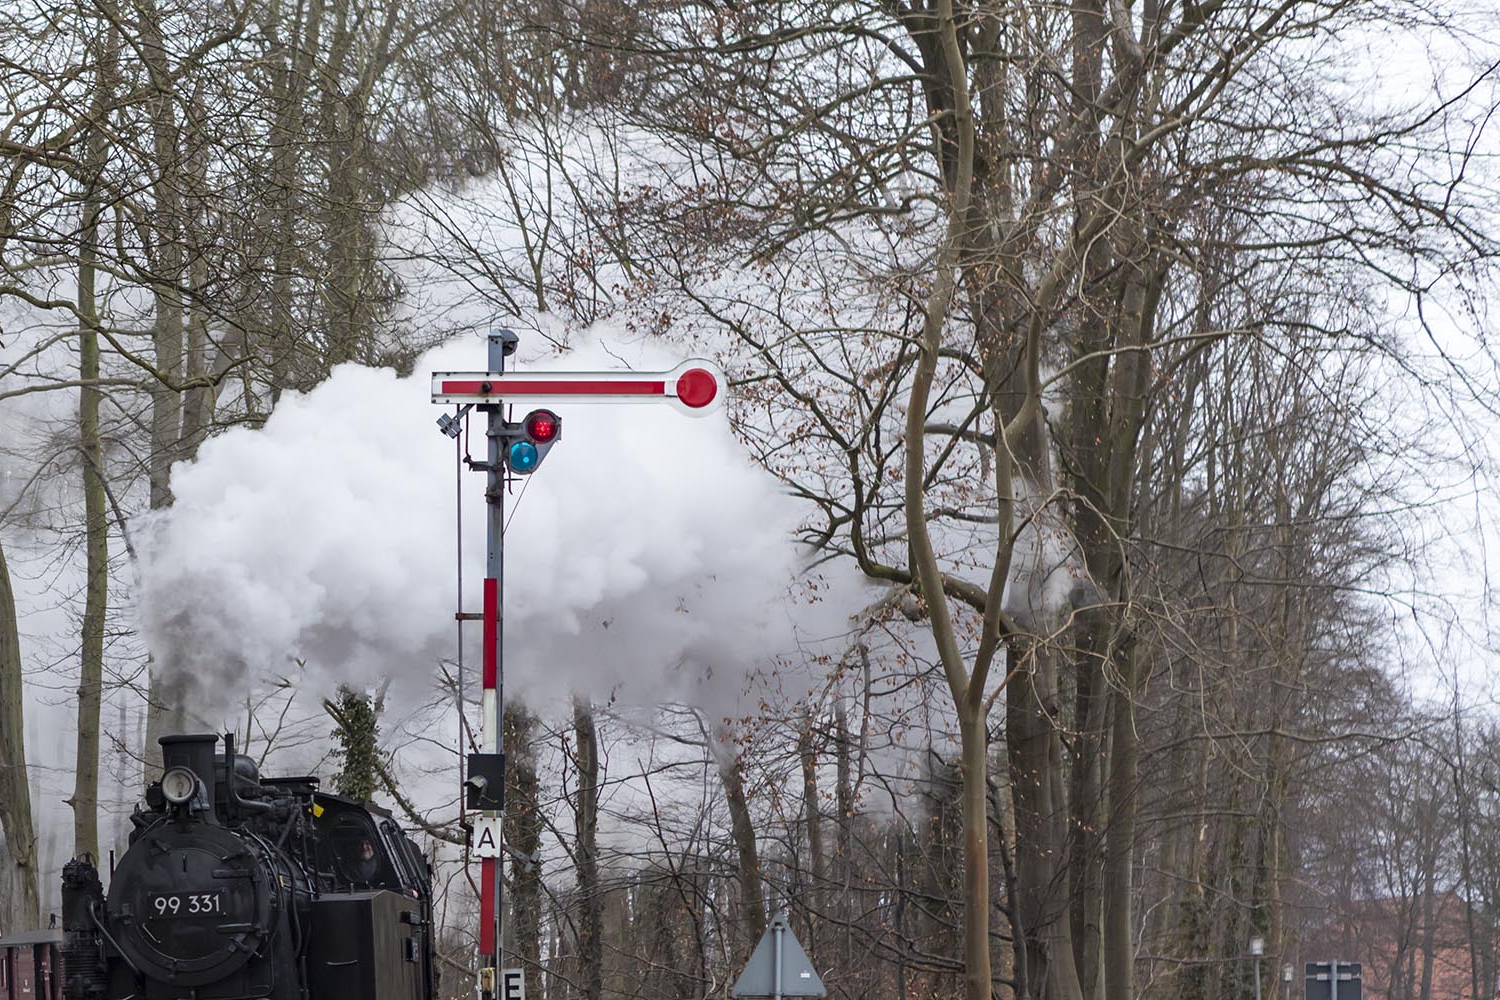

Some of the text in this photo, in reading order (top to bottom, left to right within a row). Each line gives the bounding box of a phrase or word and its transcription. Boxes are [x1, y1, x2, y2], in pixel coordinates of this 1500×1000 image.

[477, 826, 496, 849] A
[154, 894, 220, 915] 99 331
